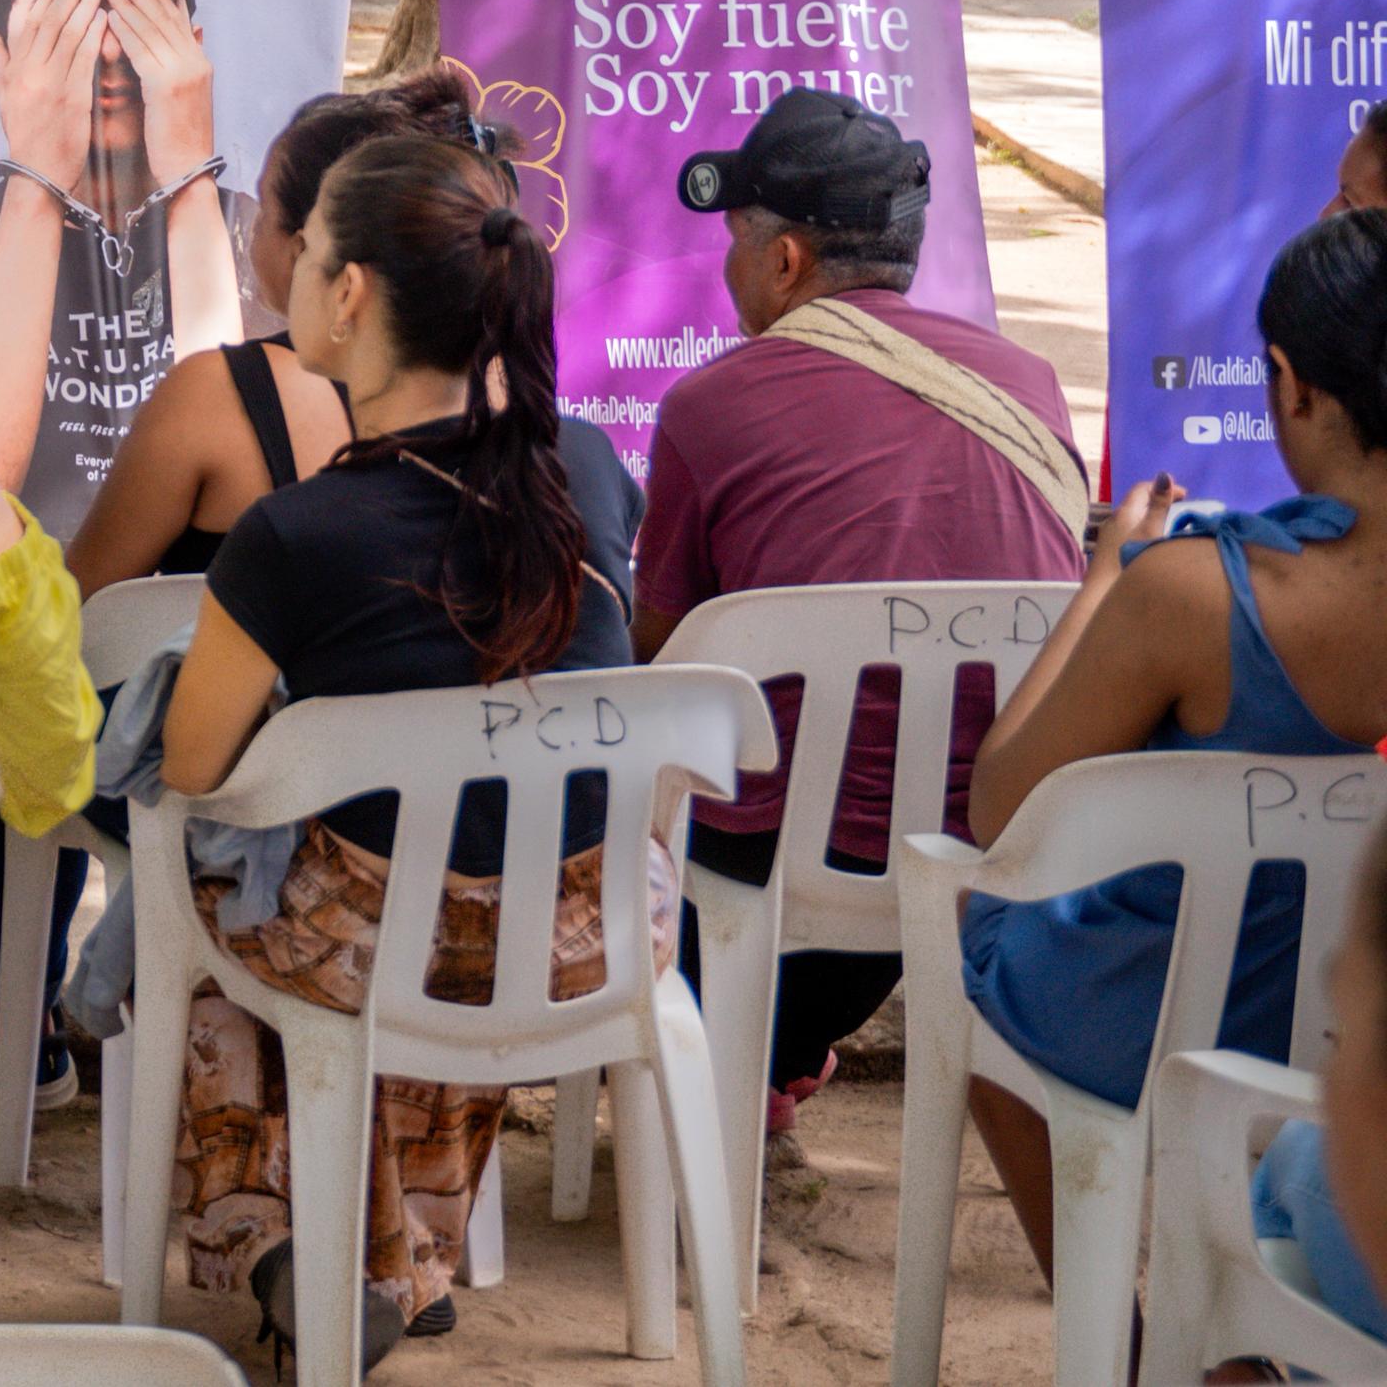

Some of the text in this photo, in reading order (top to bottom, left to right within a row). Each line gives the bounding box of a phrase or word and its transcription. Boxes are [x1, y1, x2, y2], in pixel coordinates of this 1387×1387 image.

[1265, 19, 1312, 86] Mi
[585, 52, 710, 132] Soy
[69, 309, 150, 341] THE
